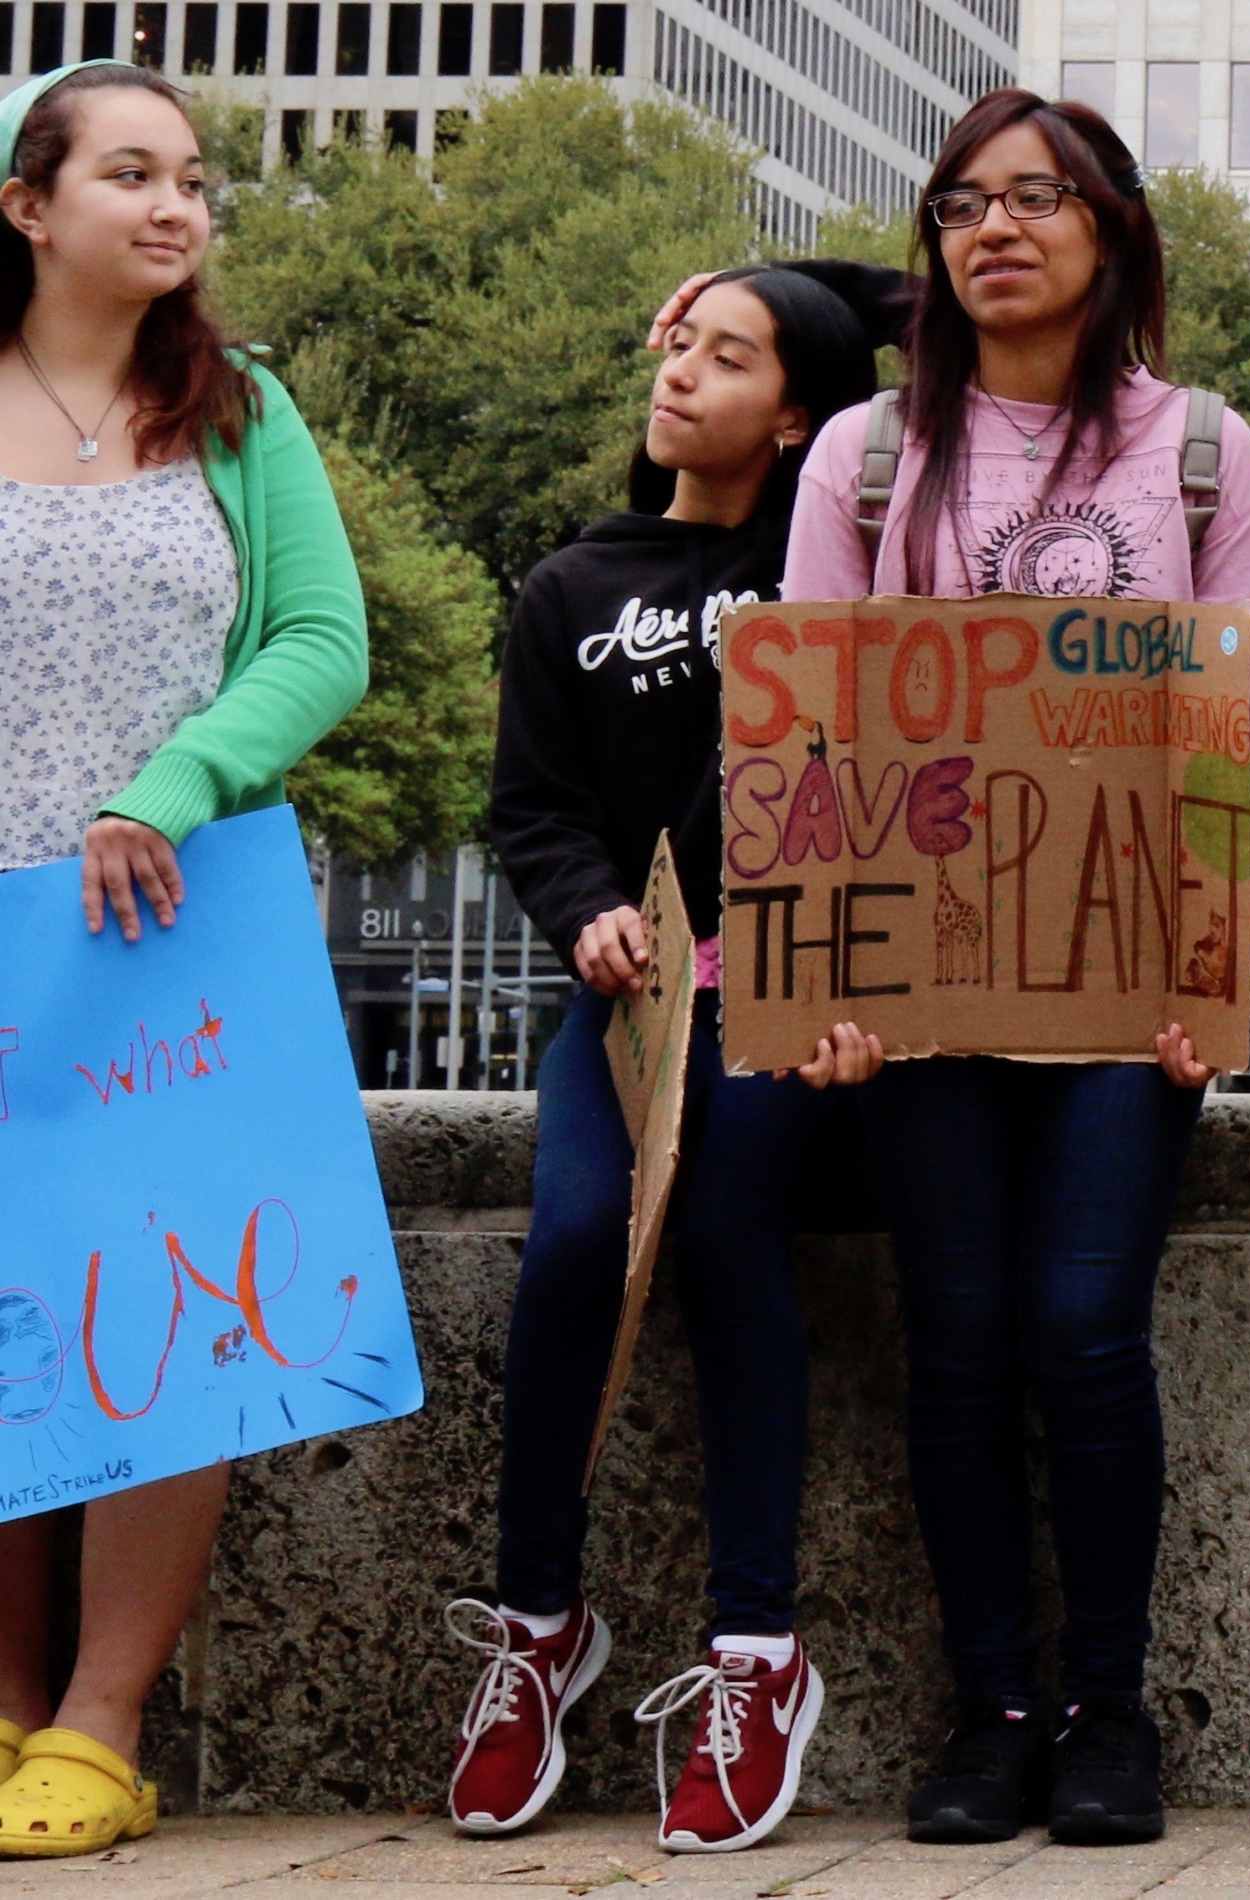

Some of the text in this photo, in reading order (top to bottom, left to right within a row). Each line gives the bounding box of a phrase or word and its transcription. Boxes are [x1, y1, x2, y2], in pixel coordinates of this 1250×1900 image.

[1126, 464, 1167, 482] SUN
[727, 614, 1039, 748] STOP
[1048, 608, 1204, 680] GLOBAL
[726, 756, 975, 880] SAVE
[361, 908, 399, 939] 811
[727, 883, 915, 1000] THE
[74, 998, 228, 1105] what
